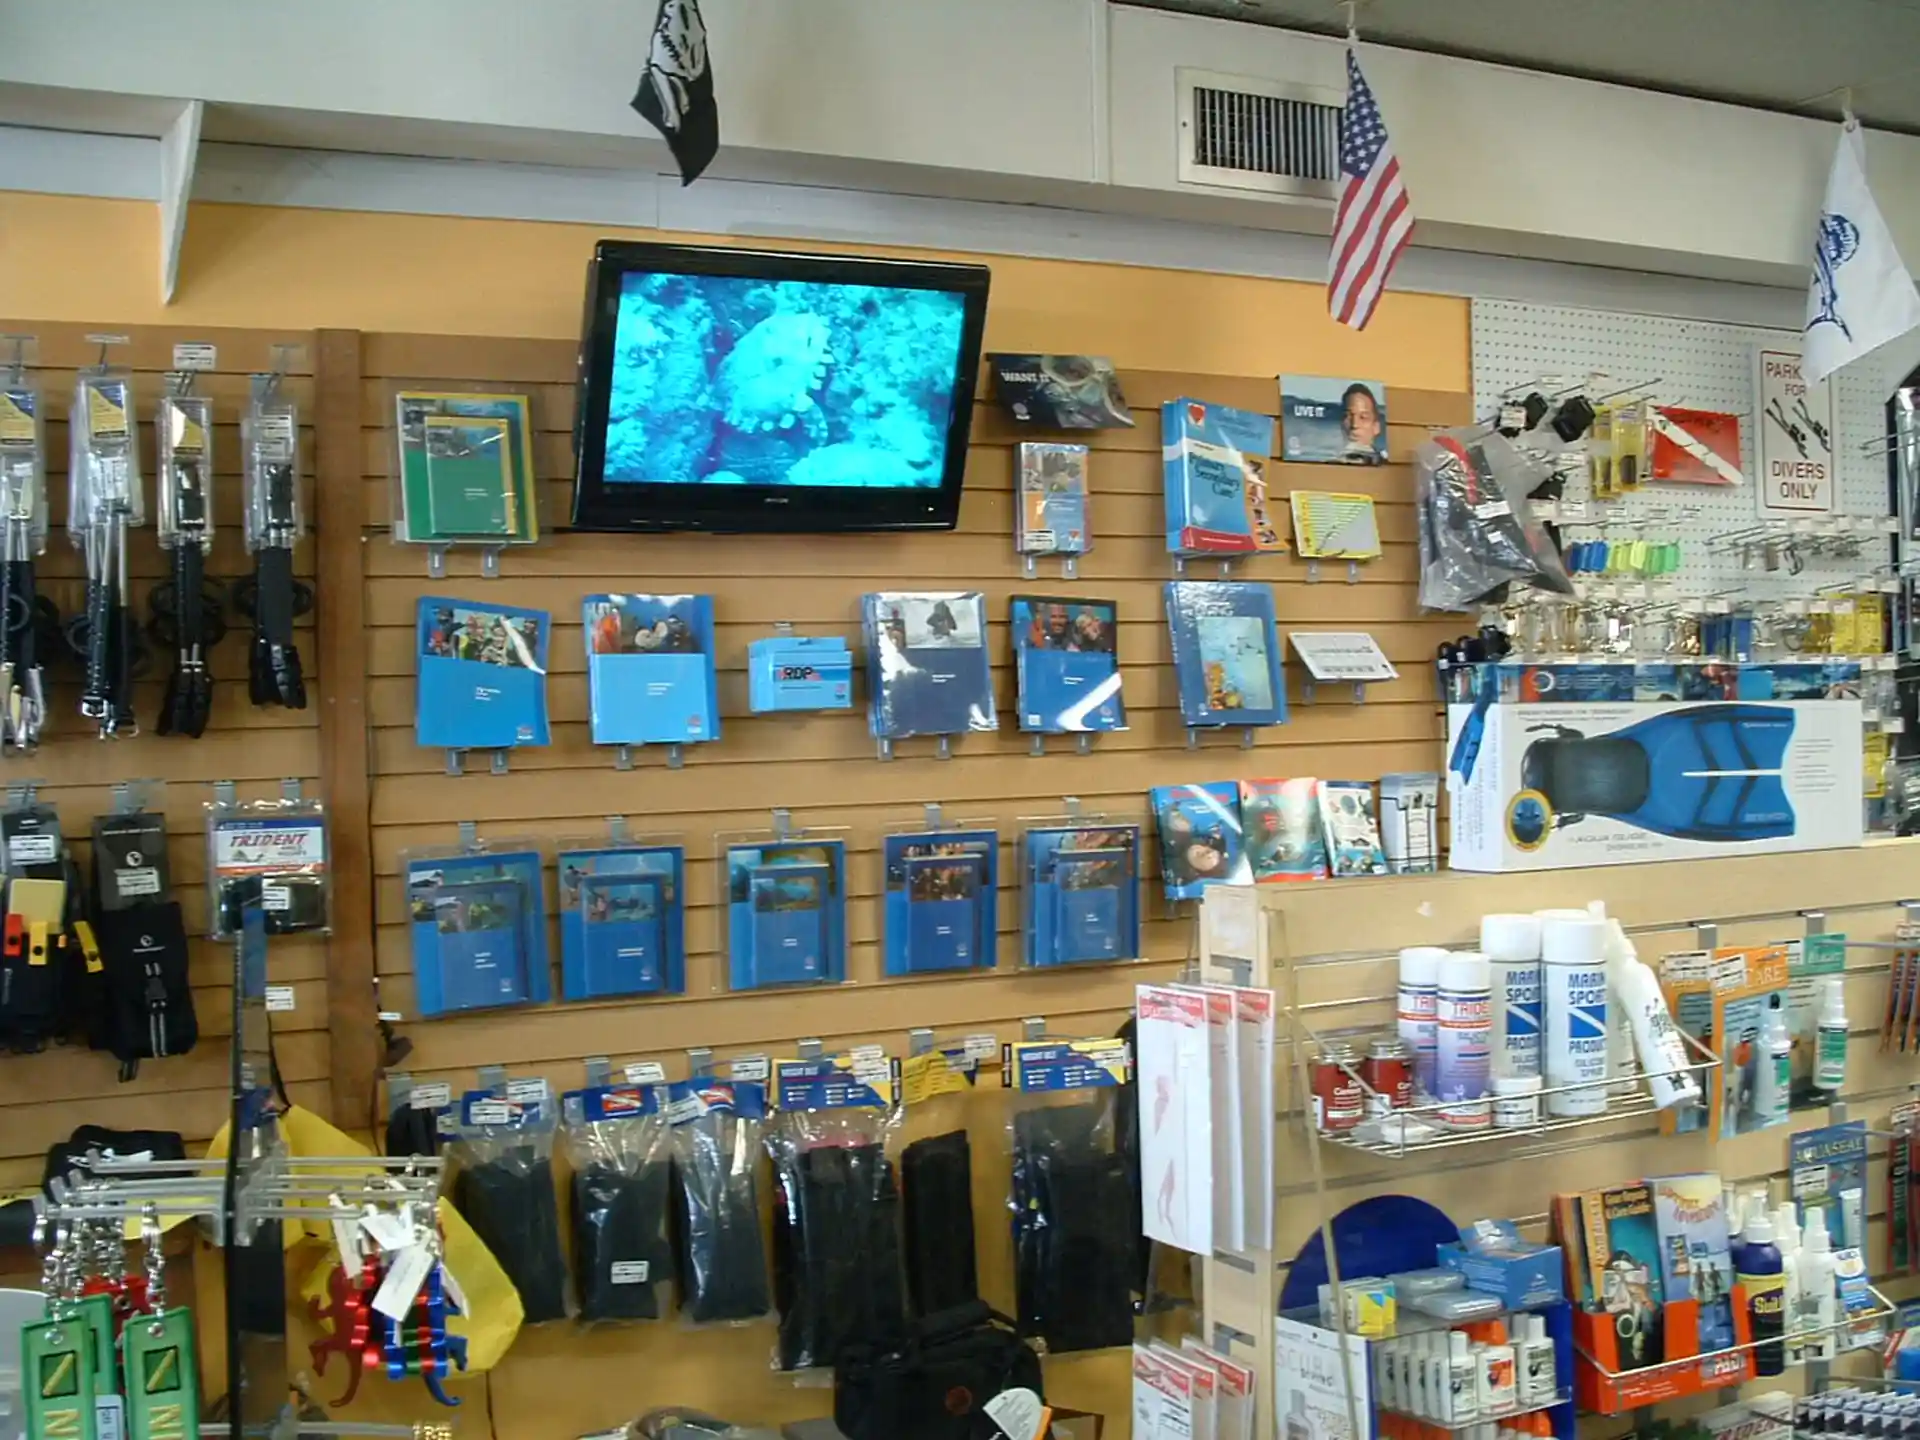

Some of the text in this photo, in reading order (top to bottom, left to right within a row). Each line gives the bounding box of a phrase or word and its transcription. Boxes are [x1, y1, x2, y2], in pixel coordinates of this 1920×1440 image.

[1766, 361, 1802, 379] PARK
[1294, 405, 1325, 418] LIVE IT
[1772, 461, 1825, 479] DIVERS
[1780, 482, 1818, 500] ONLY
[782, 666, 813, 680] RDP
[230, 832, 309, 848] TRIDENT
